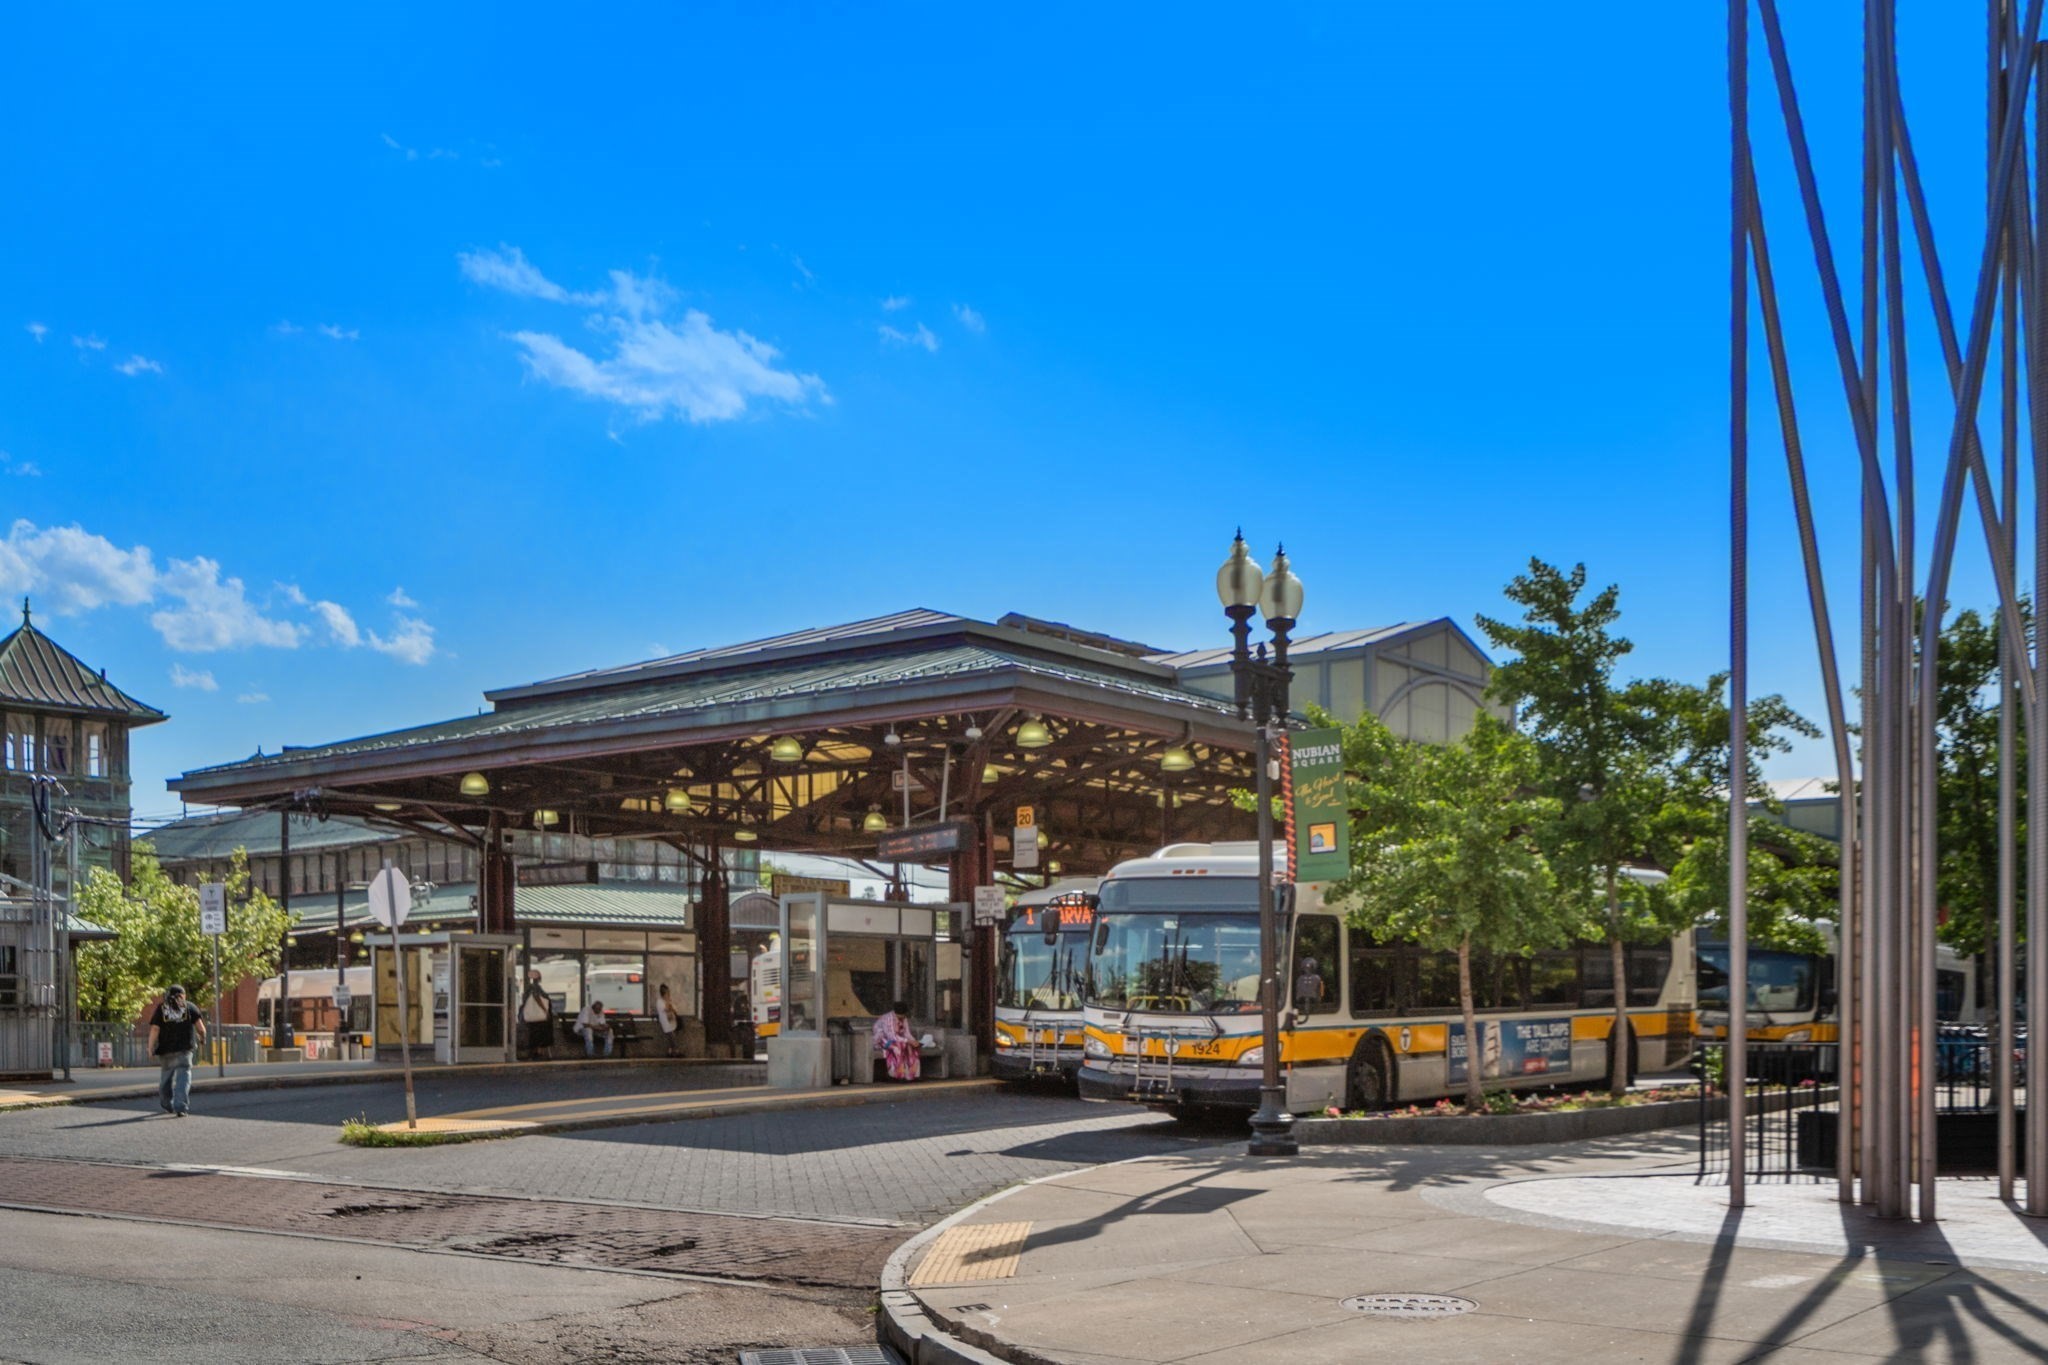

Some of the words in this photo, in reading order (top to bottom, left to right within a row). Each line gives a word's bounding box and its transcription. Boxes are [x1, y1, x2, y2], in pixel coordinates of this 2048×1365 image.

[1292, 743, 1340, 760] NUBIAN
[1292, 755, 1341, 768] SQUARE
[1019, 814, 1031, 825] 20
[1026, 907, 1034, 926] 1
[1192, 1044, 1220, 1055] 1924
